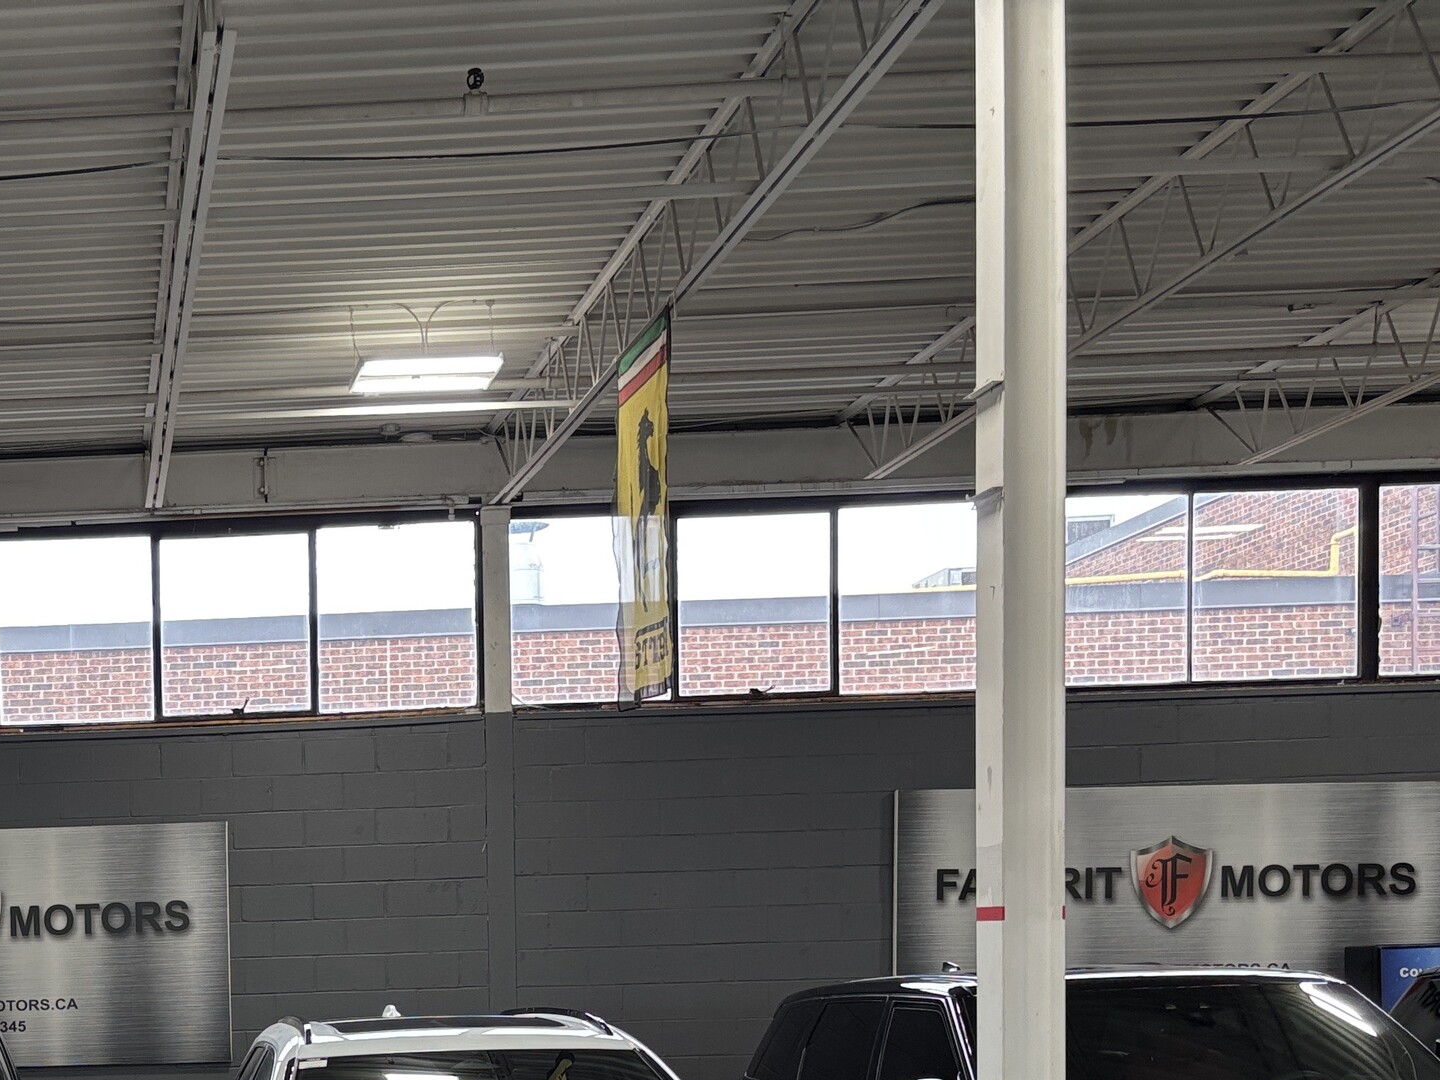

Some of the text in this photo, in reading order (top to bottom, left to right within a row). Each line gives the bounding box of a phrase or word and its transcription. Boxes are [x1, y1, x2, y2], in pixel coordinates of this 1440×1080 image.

[936, 867, 1122, 900] FARIT
[1220, 862, 1417, 898] MOTORS
[10, 900, 190, 937] MOTORS
